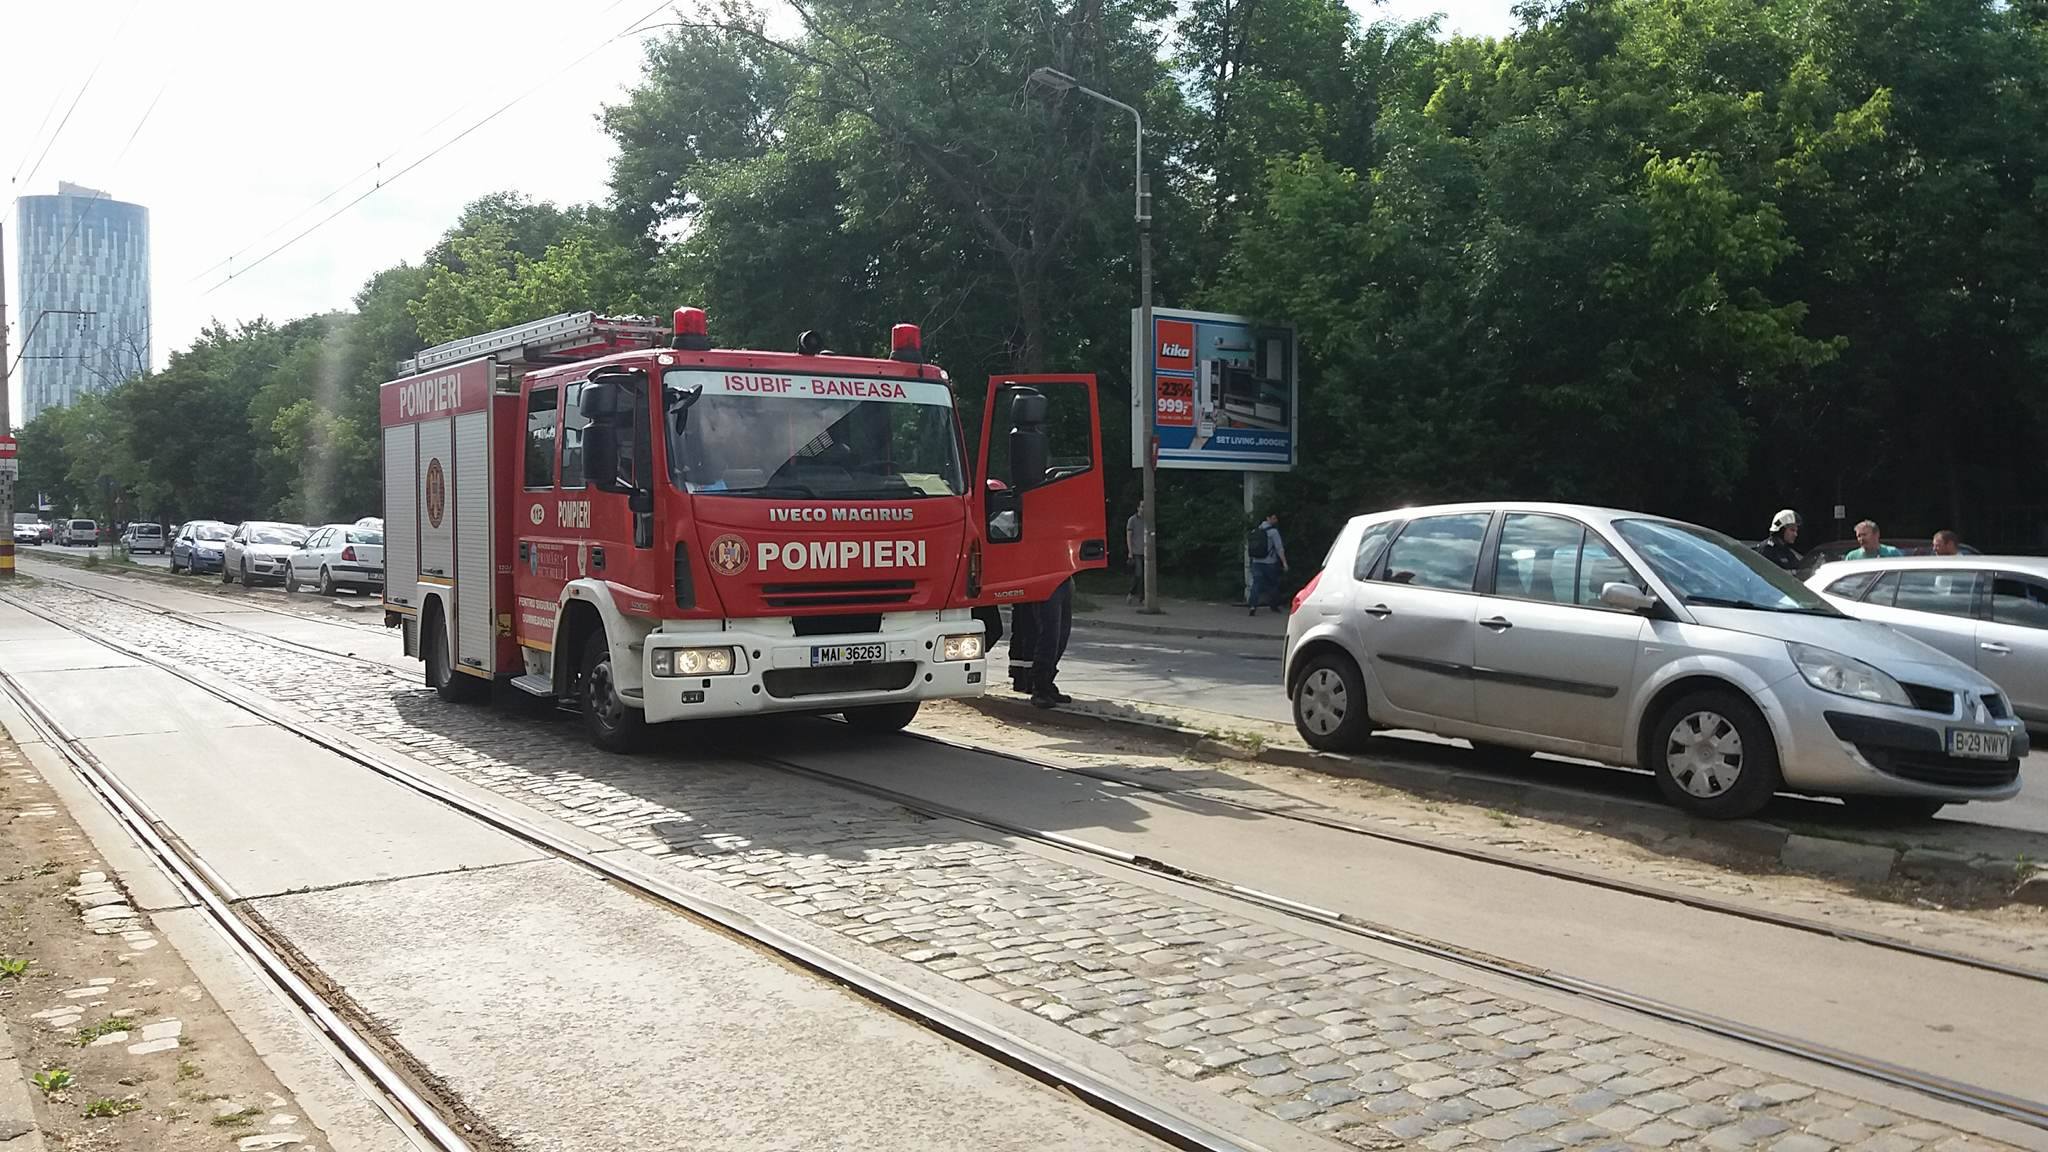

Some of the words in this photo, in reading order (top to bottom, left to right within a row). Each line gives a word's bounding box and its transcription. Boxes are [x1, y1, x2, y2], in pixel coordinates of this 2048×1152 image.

[1162, 343, 1190, 356] kika
[400, 373, 461, 418] POMPIERI
[724, 375, 792, 393] ISUBIF
[811, 379, 907, 399] BANEASA
[1216, 436, 1230, 444] SET
[1231, 436, 1255, 445] LIVING
[532, 506, 543, 520] 112
[558, 501, 590, 528] POMPIERI
[769, 507, 827, 522] IVECO
[831, 507, 914, 522] MAGIRUS
[757, 540, 926, 570] POMPIERI
[821, 647, 840, 662] MAI
[845, 645, 882, 660] 36263
[1956, 733, 1965, 750] B
[1968, 734, 1981, 752] 29
[1983, 736, 2005, 754] NWY
